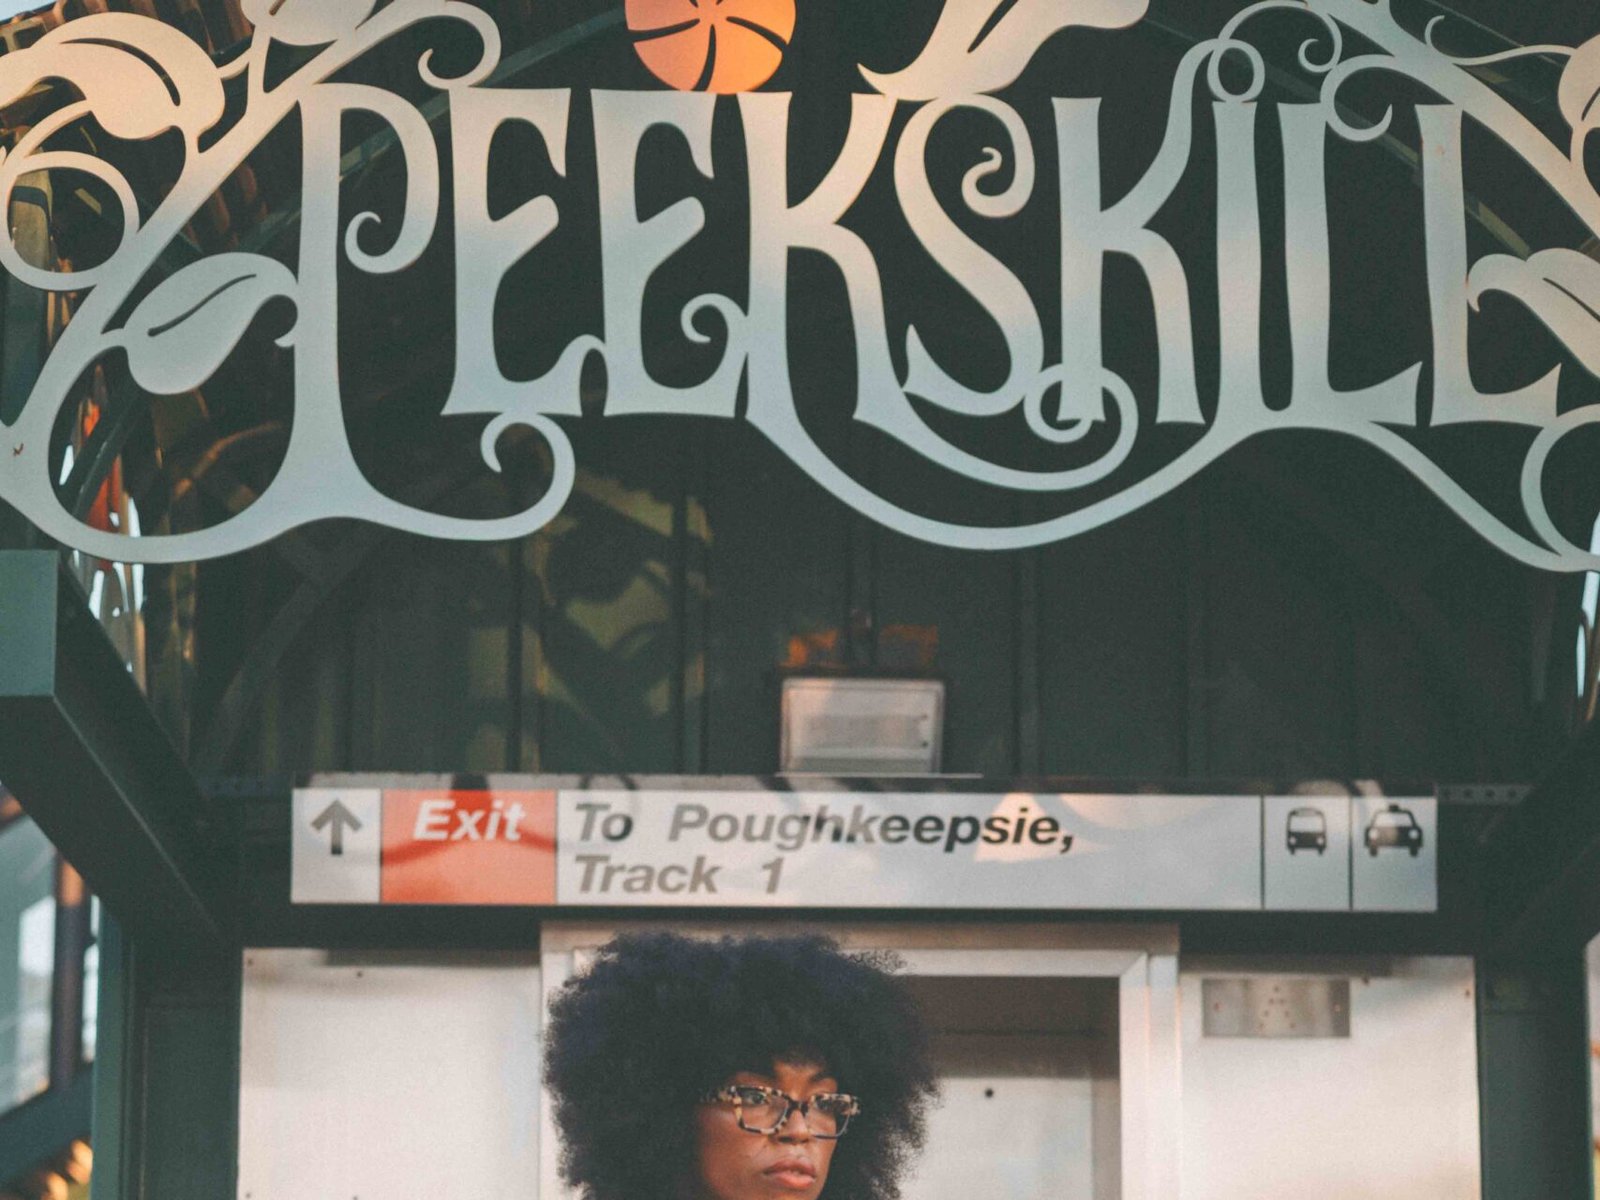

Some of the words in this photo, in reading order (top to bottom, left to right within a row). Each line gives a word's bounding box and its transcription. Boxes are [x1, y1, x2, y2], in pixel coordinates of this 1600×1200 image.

[285, 80, 1563, 495] PEEKSKILL
[413, 799, 527, 842] Exit
[574, 802, 634, 842] To
[668, 803, 1074, 854] Poughkeepsie,
[574, 855, 723, 895] Track
[762, 857, 786, 894] 1
